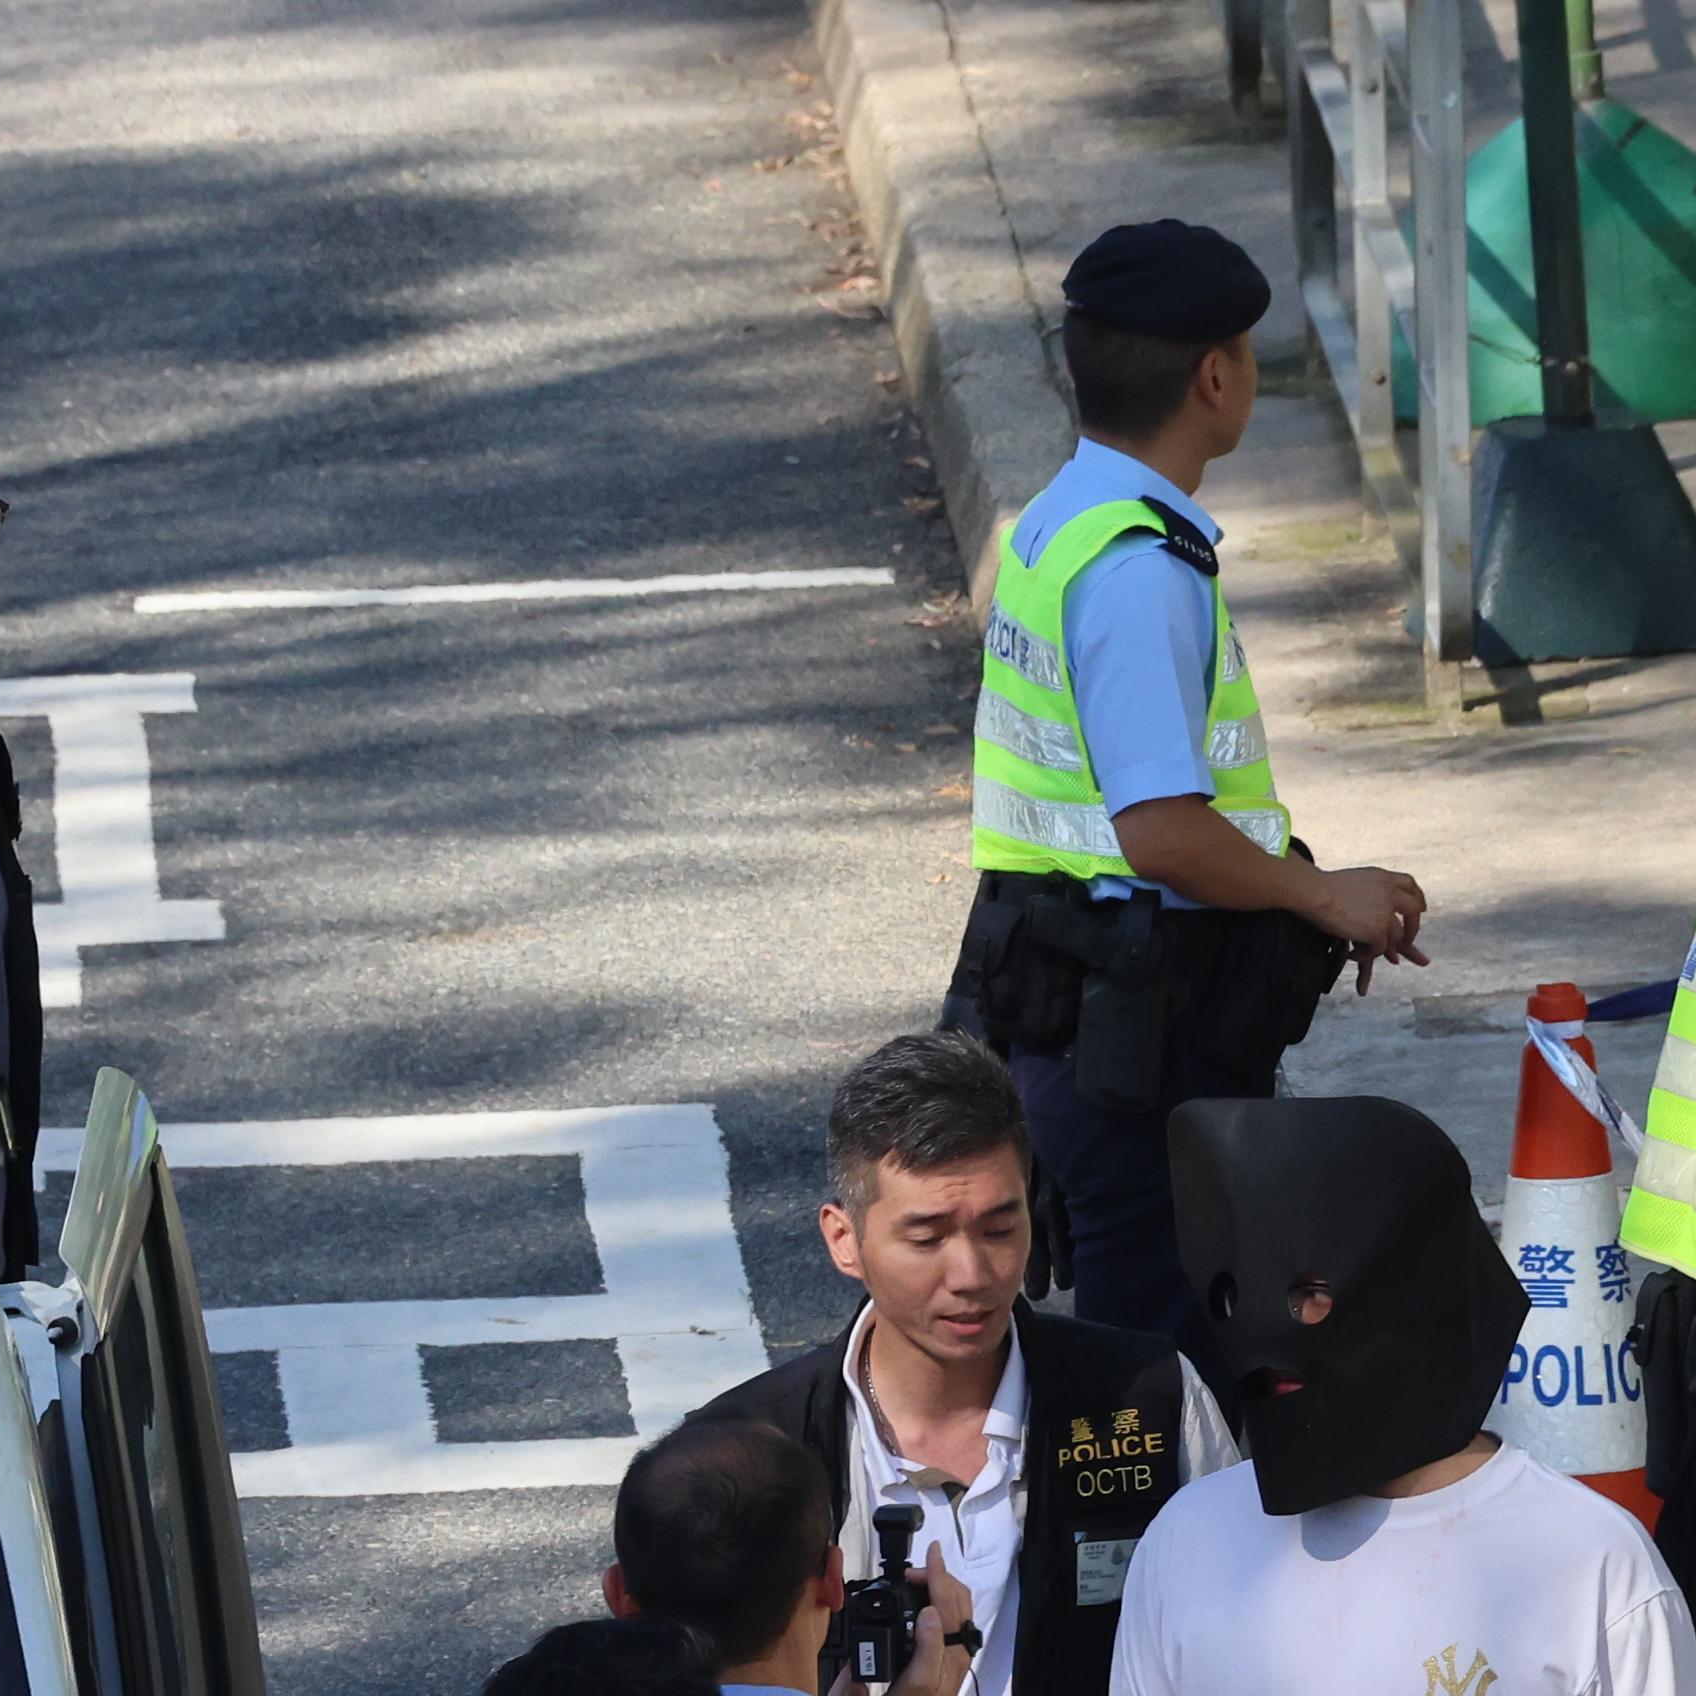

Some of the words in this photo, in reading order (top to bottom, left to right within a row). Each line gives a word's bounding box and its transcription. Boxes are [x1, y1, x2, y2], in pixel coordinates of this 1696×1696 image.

[1518, 1239, 1632, 1308] 警察
[1501, 1339, 1641, 1407] POLIC
[1058, 1432, 1164, 1469] POLICE
[1076, 1465, 1152, 1497] OCTB
